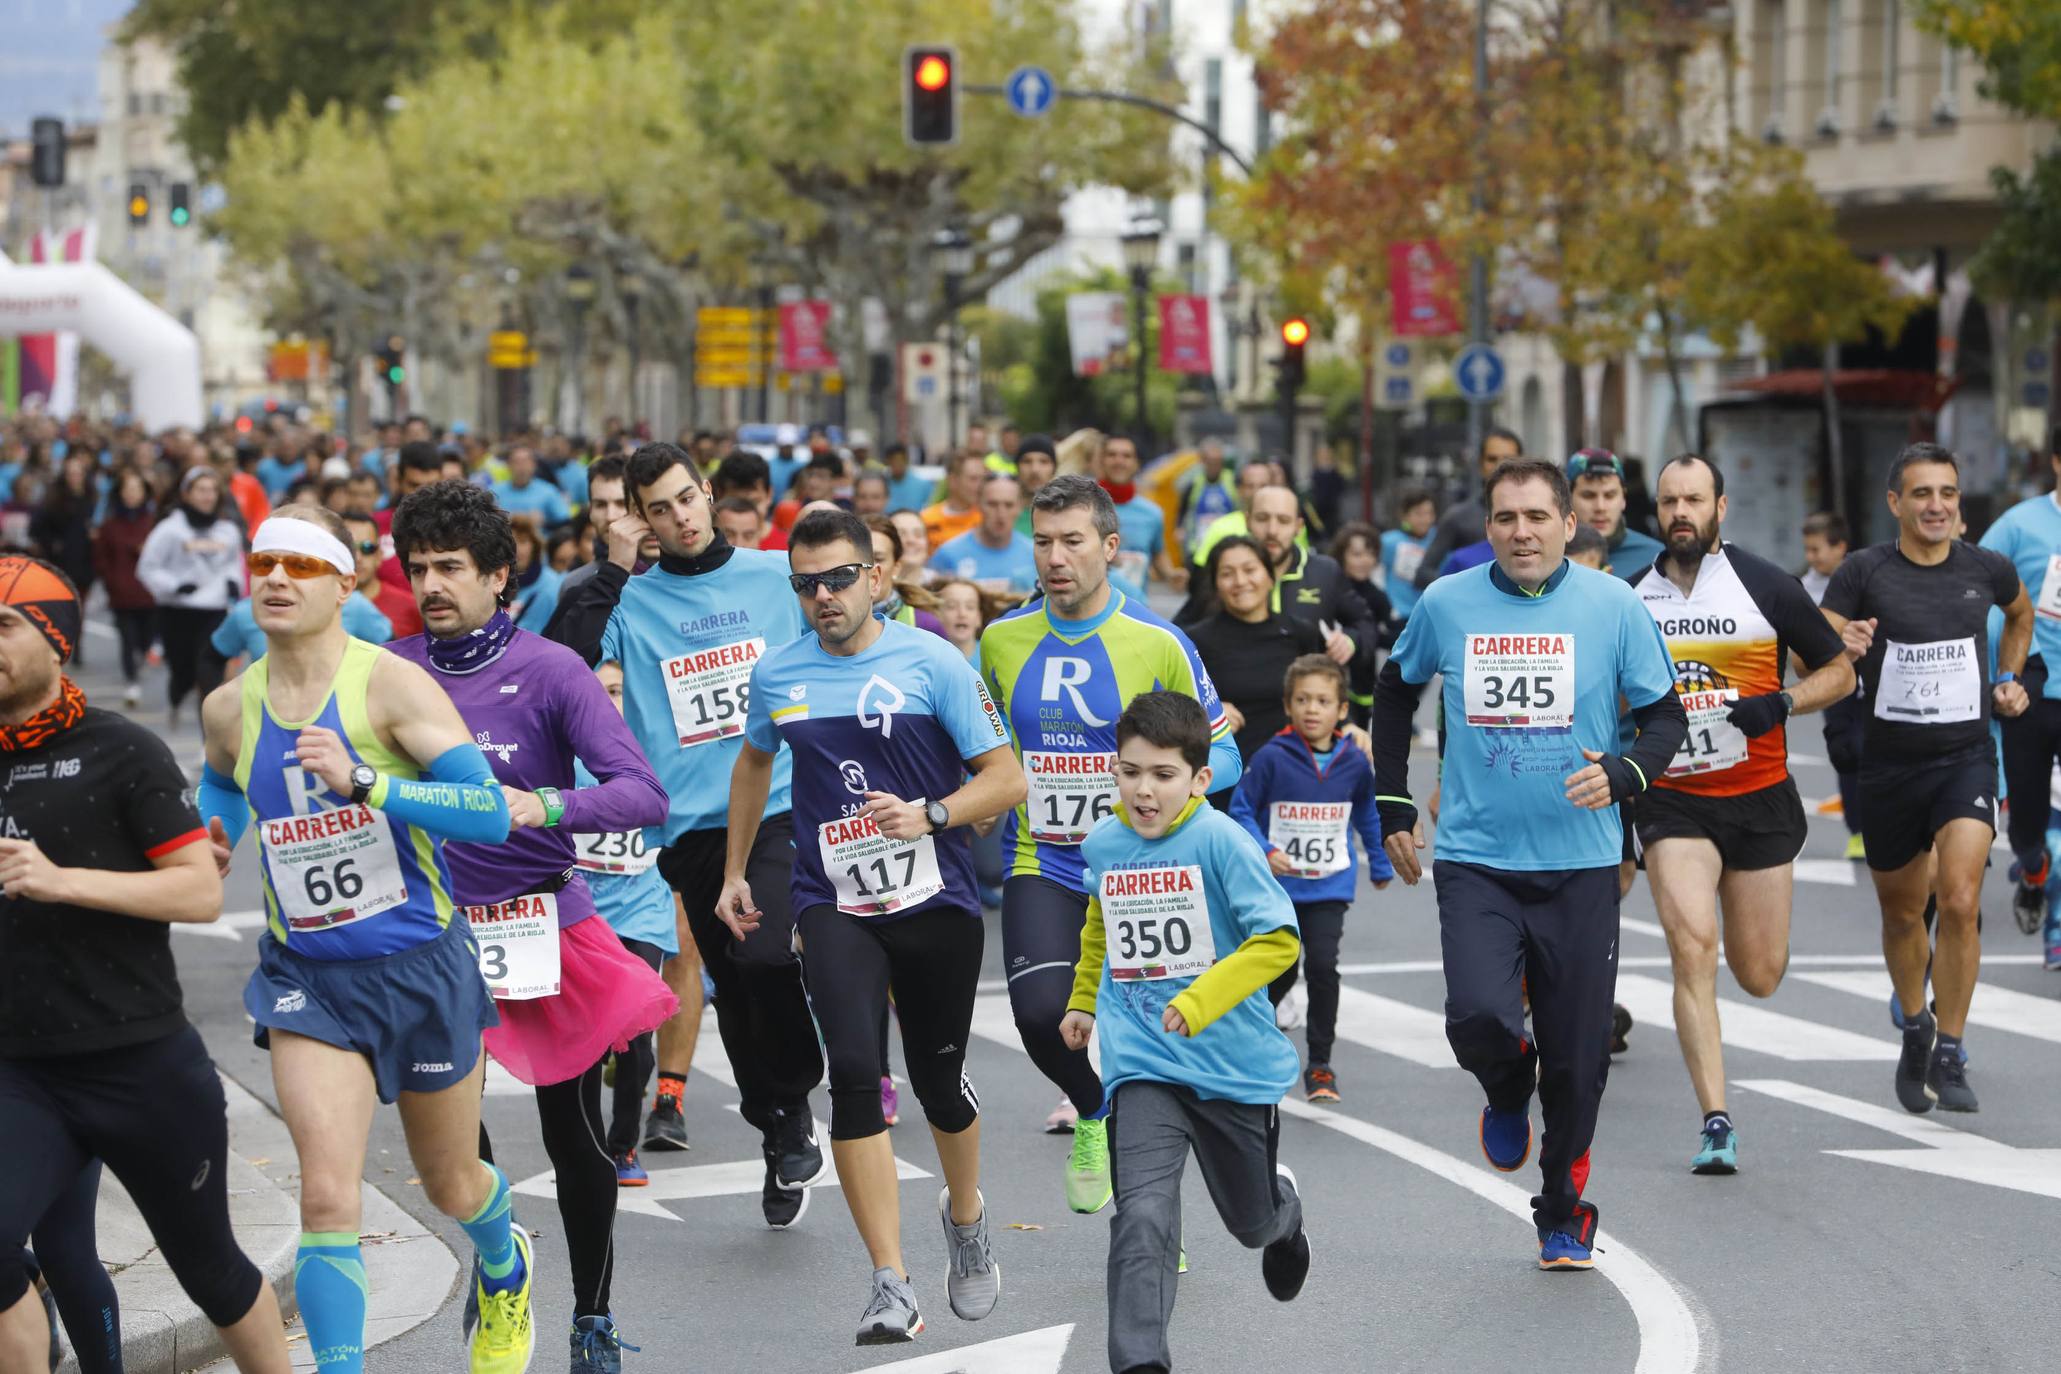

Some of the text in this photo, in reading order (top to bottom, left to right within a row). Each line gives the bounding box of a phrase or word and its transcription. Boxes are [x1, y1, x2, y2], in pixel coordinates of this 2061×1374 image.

[679, 610, 750, 634] CARRERA
[1473, 637, 1566, 655] CARRERA
[1897, 644, 1967, 663] CARRERA
[669, 642, 758, 679] CARRERA
[1483, 675, 1556, 709] 345
[1903, 680, 1941, 699] 761
[690, 682, 750, 726] 158
[976, 680, 1005, 737] CROWN
[1039, 707, 1063, 719] CLUB
[1040, 720, 1085, 734] MARATÓN
[1041, 733, 1088, 748] RIOJA
[399, 783, 499, 812] MARATÓN RIOJA
[1044, 793, 1113, 827] 176
[269, 806, 376, 846] CARRERA
[1278, 804, 1345, 821] CARRERA
[587, 830, 646, 858] 230
[825, 815, 880, 846] CARR
[1285, 837, 1335, 864] 465
[304, 858, 363, 906] 66
[847, 849, 917, 897] 117
[1106, 870, 1194, 897] CARRERA
[1118, 917, 1192, 960] 350
[1168, 961, 1206, 972] LABORAL
